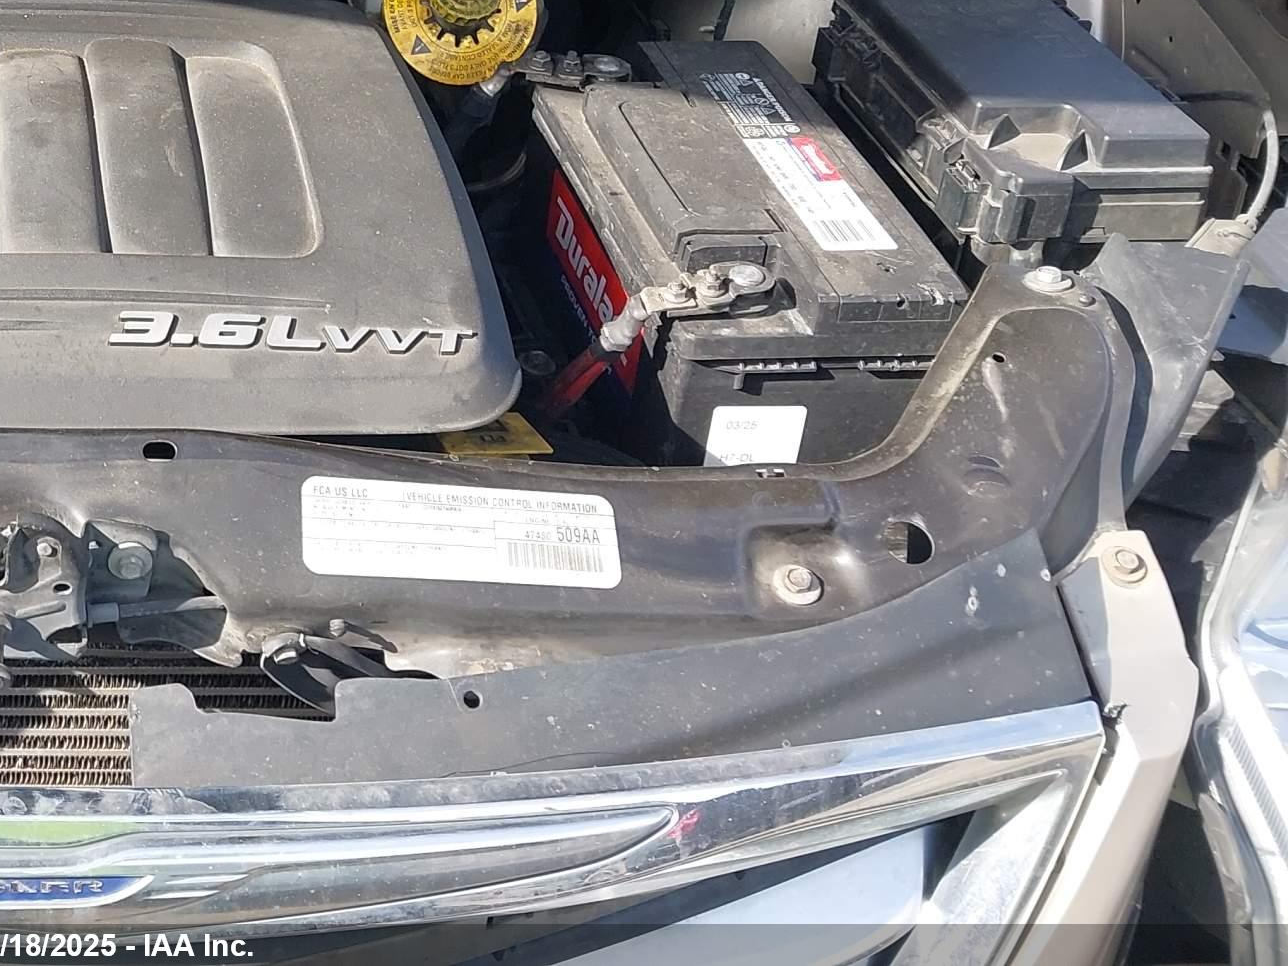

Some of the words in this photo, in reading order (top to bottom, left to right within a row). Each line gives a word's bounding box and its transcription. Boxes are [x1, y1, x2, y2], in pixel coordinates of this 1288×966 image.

[313, 485, 332, 496] FCA
[334, 486, 348, 497] US
[351, 487, 368, 498] LLC
[406, 491, 442, 504] VEHICLE
[446, 494, 489, 506] EMISSION
[492, 497, 533, 510] CONTROL
[536, 500, 598, 514] INFORMATION
[556, 526, 601, 544] 509AA
